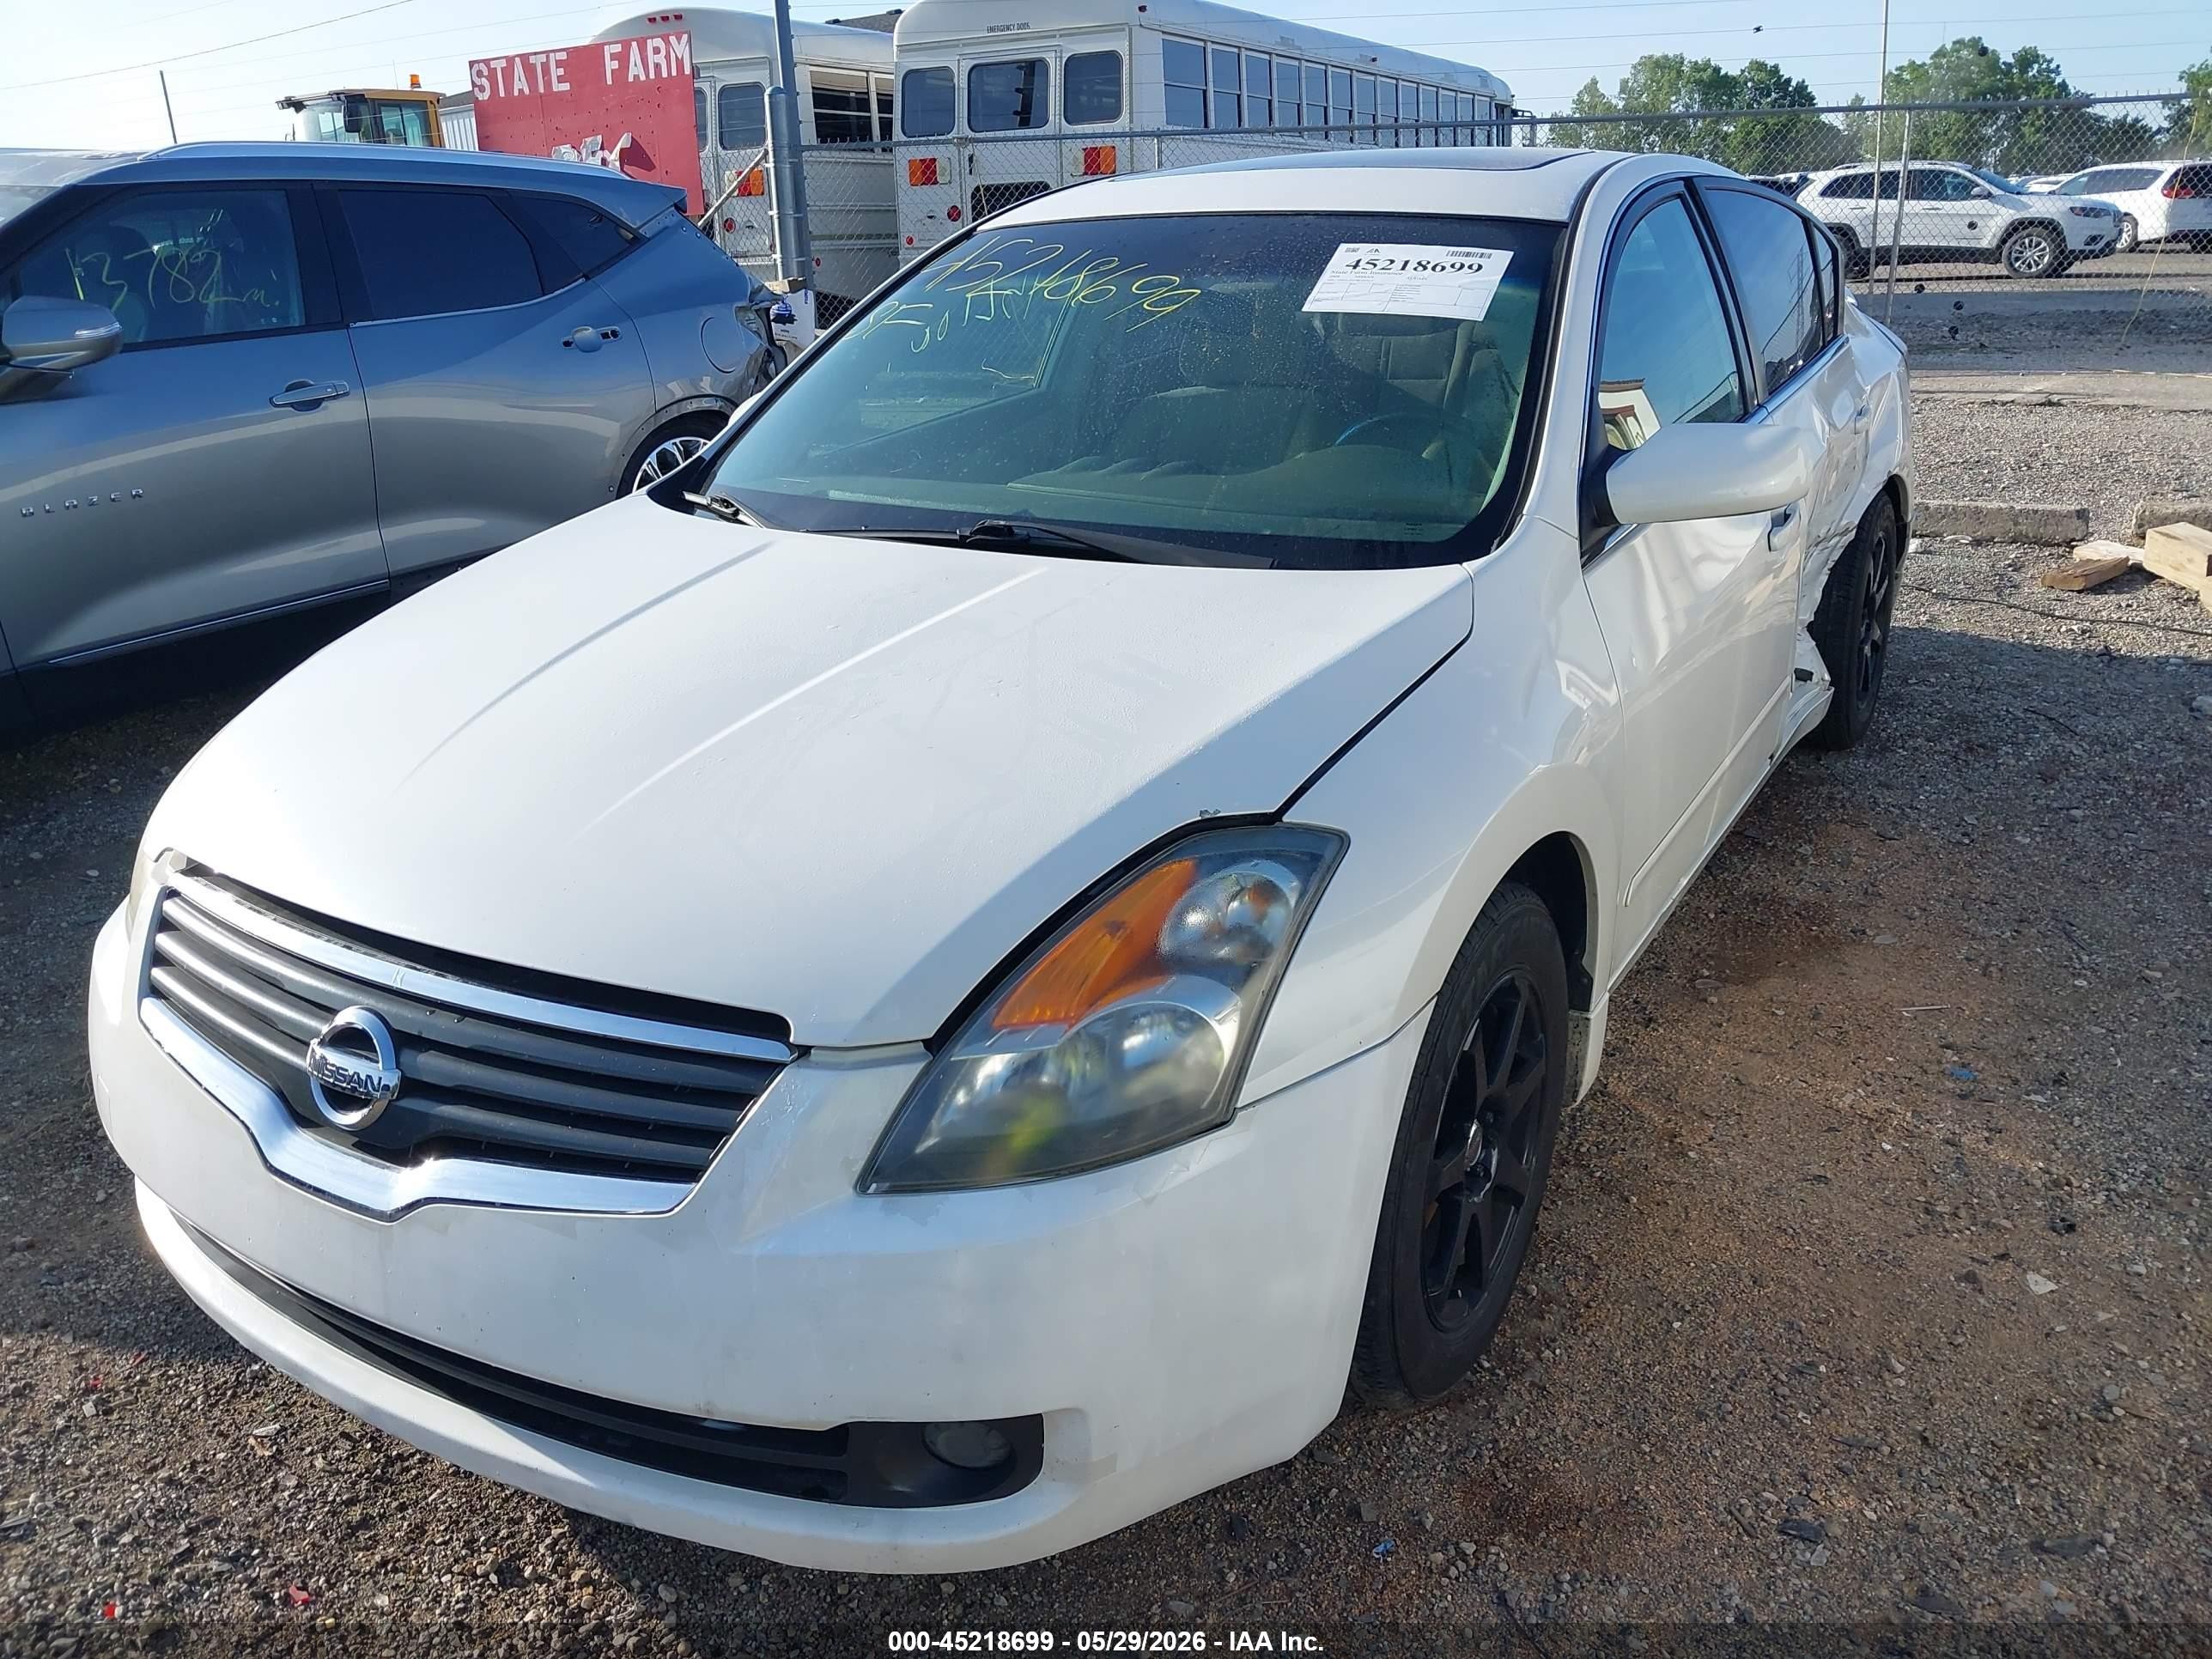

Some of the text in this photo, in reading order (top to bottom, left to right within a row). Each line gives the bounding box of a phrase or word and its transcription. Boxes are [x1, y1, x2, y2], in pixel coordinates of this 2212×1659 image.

[987, 23, 1016, 33] EMERGENCY
[471, 33, 691, 100] STATE FARM
[1346, 258, 1484, 275] 45218699
[21, 487, 144, 517] BLAZER
[308, 1055, 383, 1098] NISSAN
